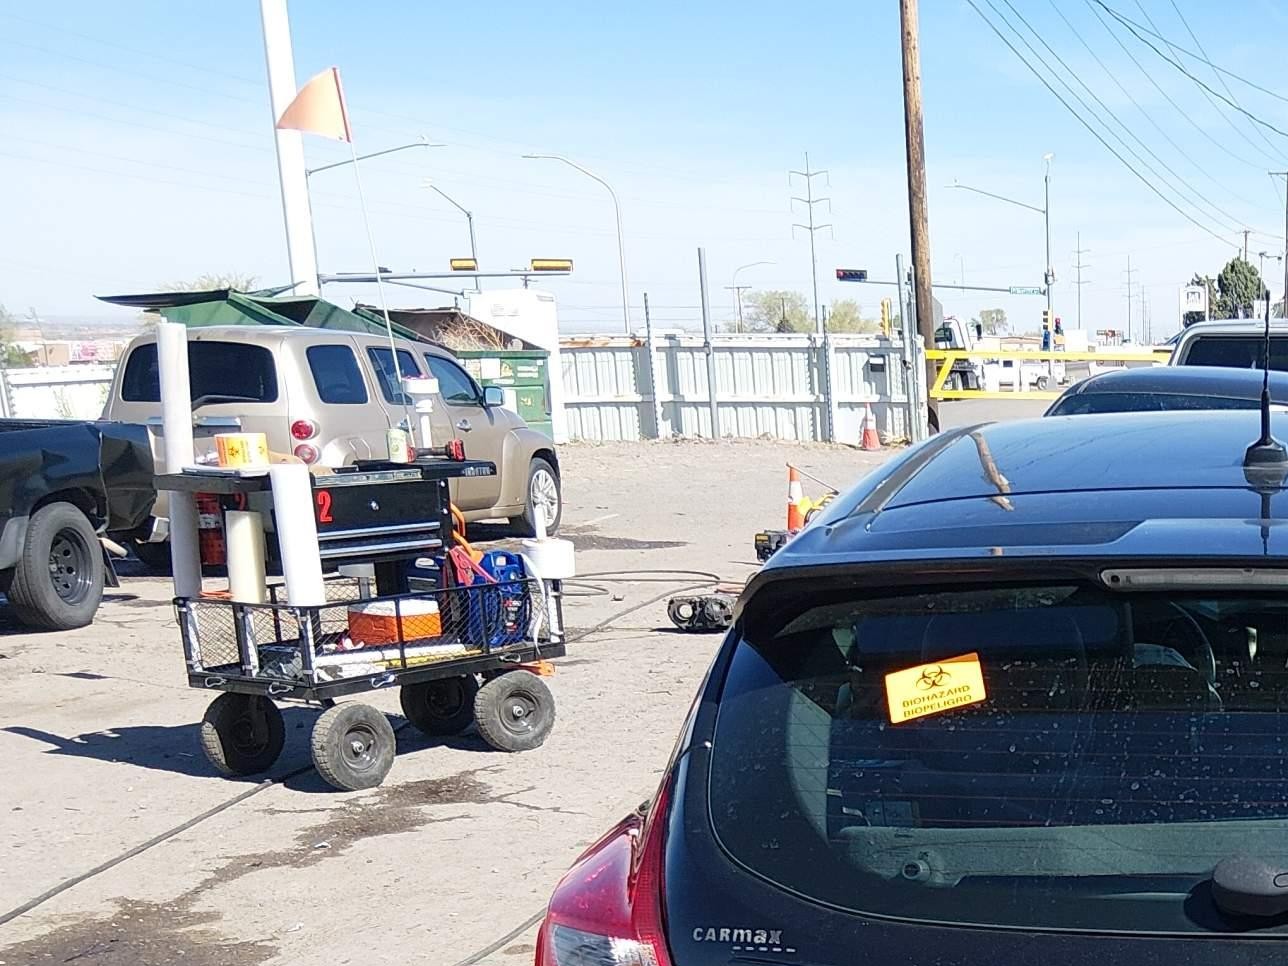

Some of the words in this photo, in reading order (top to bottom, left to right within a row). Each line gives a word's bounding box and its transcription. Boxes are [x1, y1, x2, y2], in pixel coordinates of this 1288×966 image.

[317, 490, 333, 522] 2
[902, 685, 971, 708] BIOHAZARD
[903, 694, 972, 718] BIOPELIGRO
